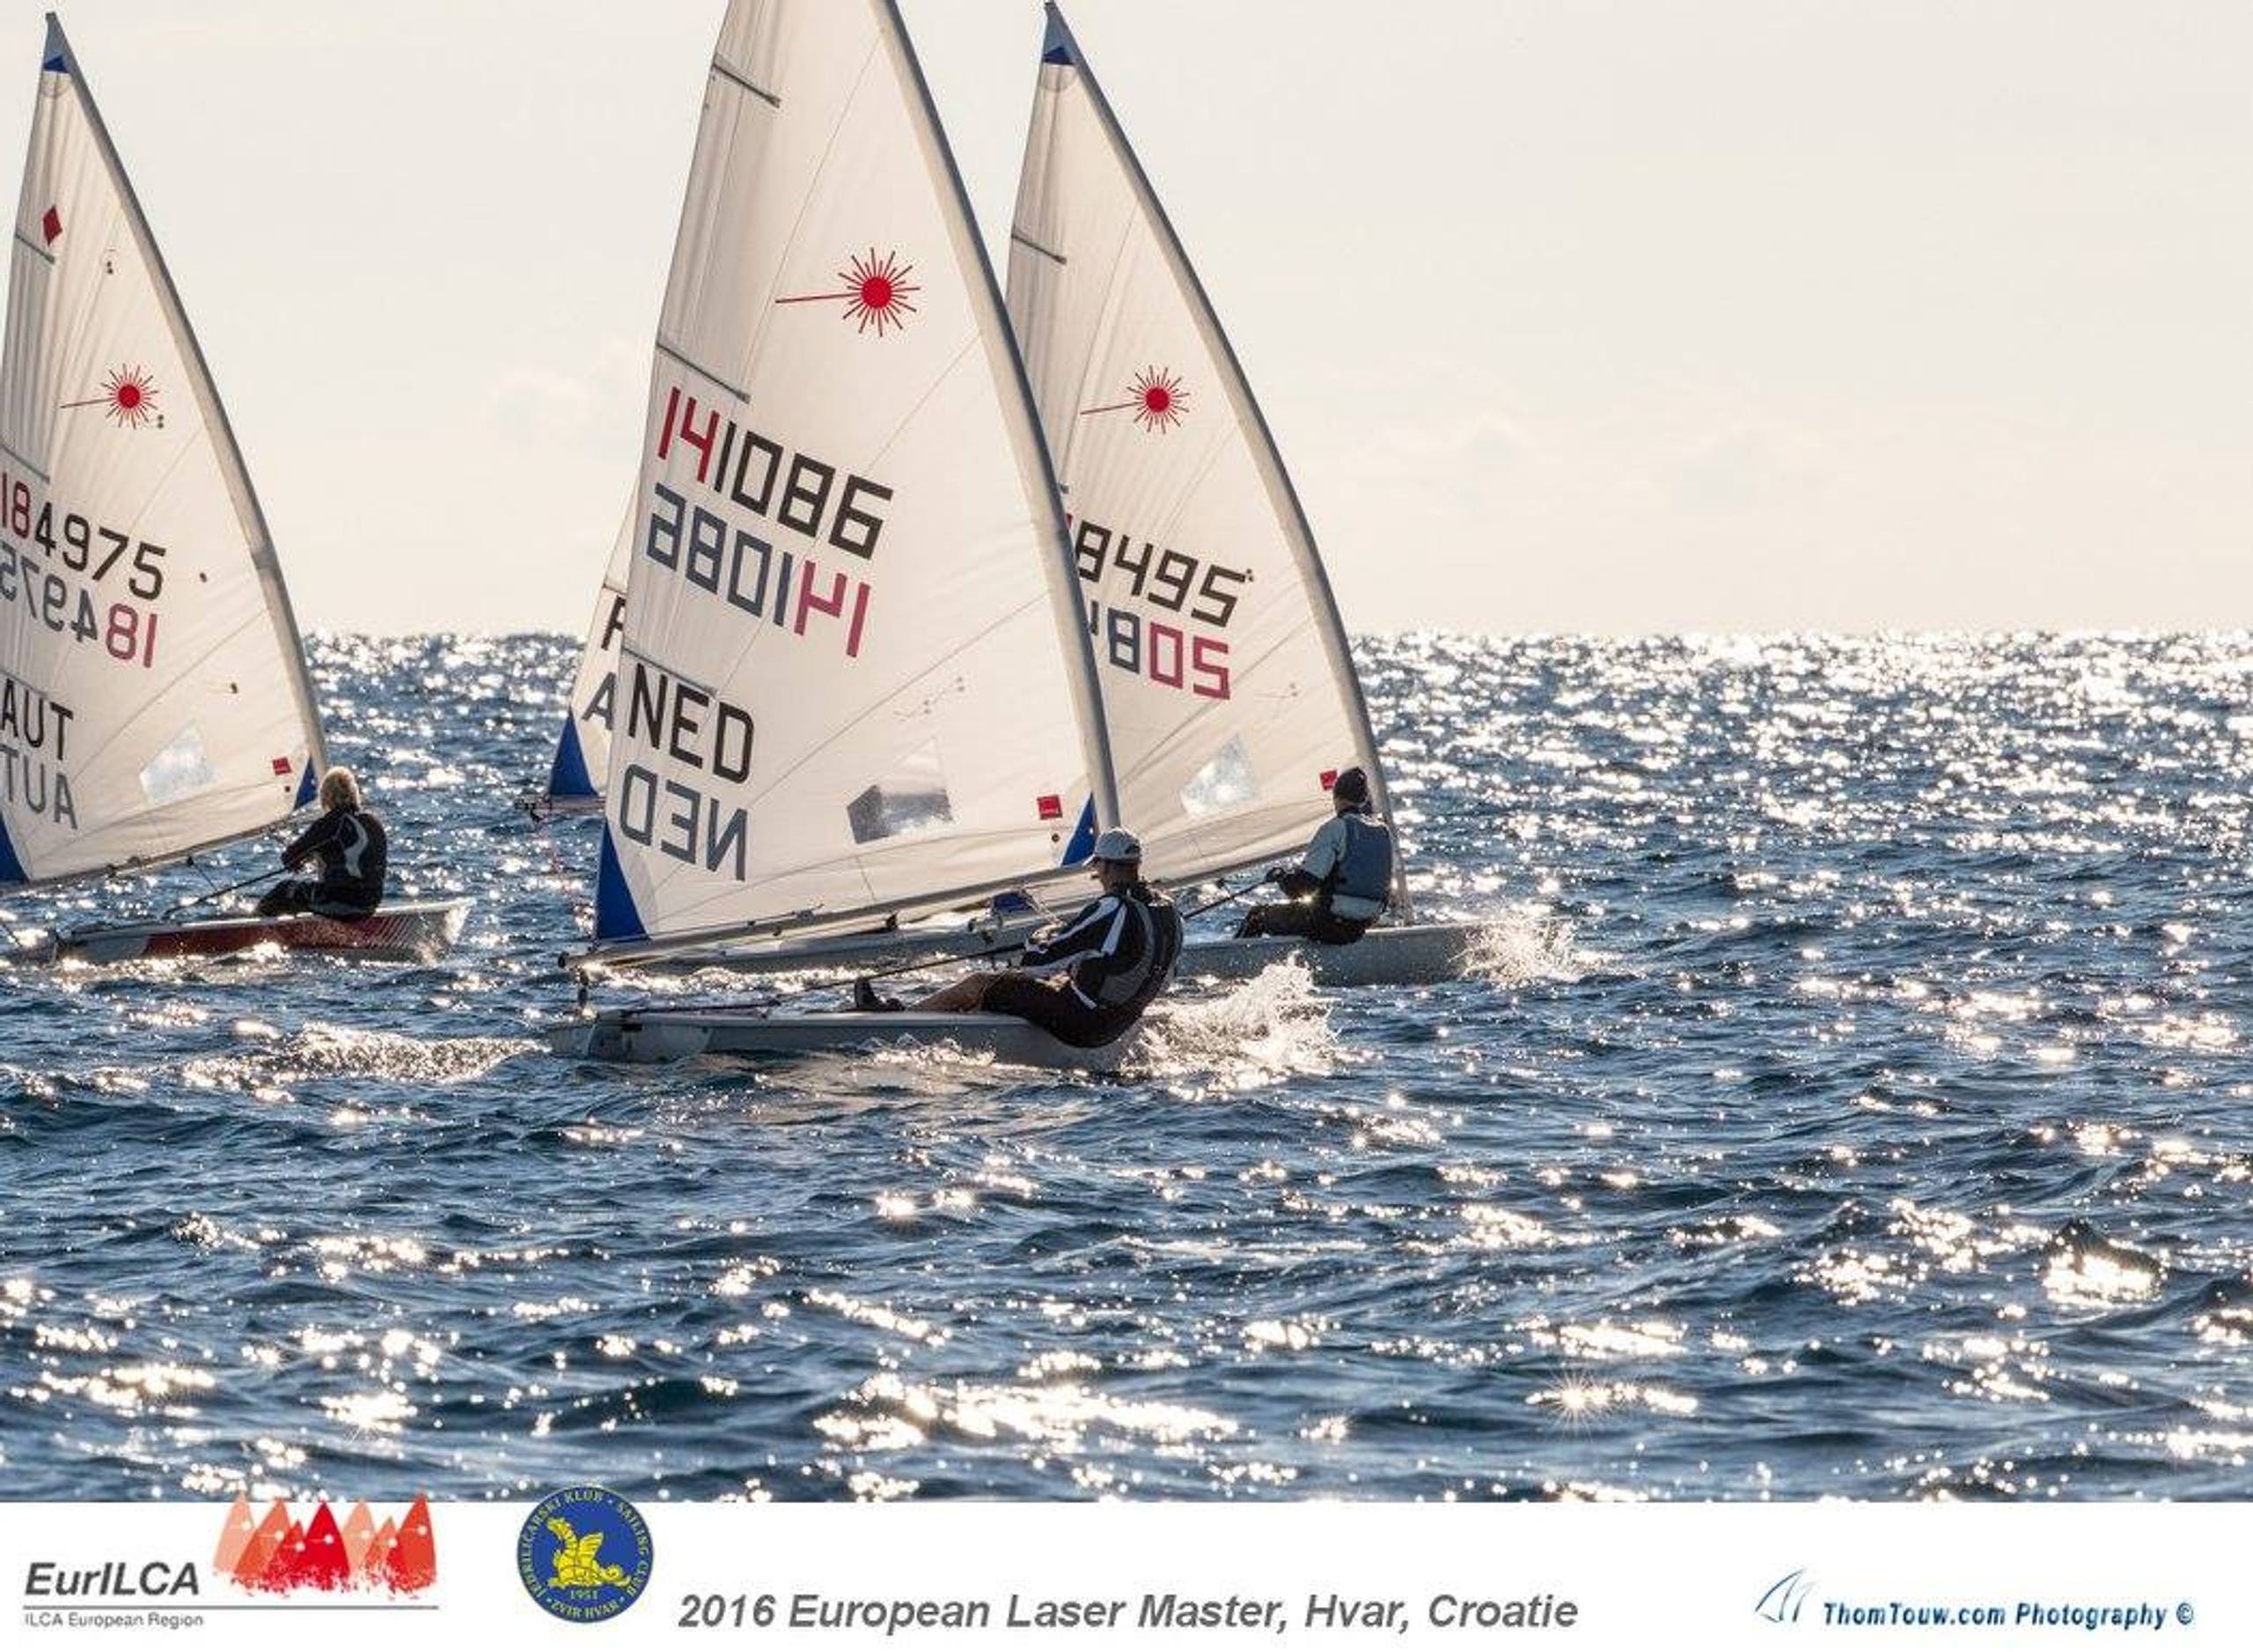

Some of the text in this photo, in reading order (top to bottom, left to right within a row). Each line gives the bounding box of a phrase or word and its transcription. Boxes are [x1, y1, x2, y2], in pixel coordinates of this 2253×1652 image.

[658, 387, 893, 561] 141086
[2, 472, 166, 600] 184975
[1066, 513, 1246, 628] 8495
[0, 678, 74, 760] AUT
[627, 663, 754, 785] NED
